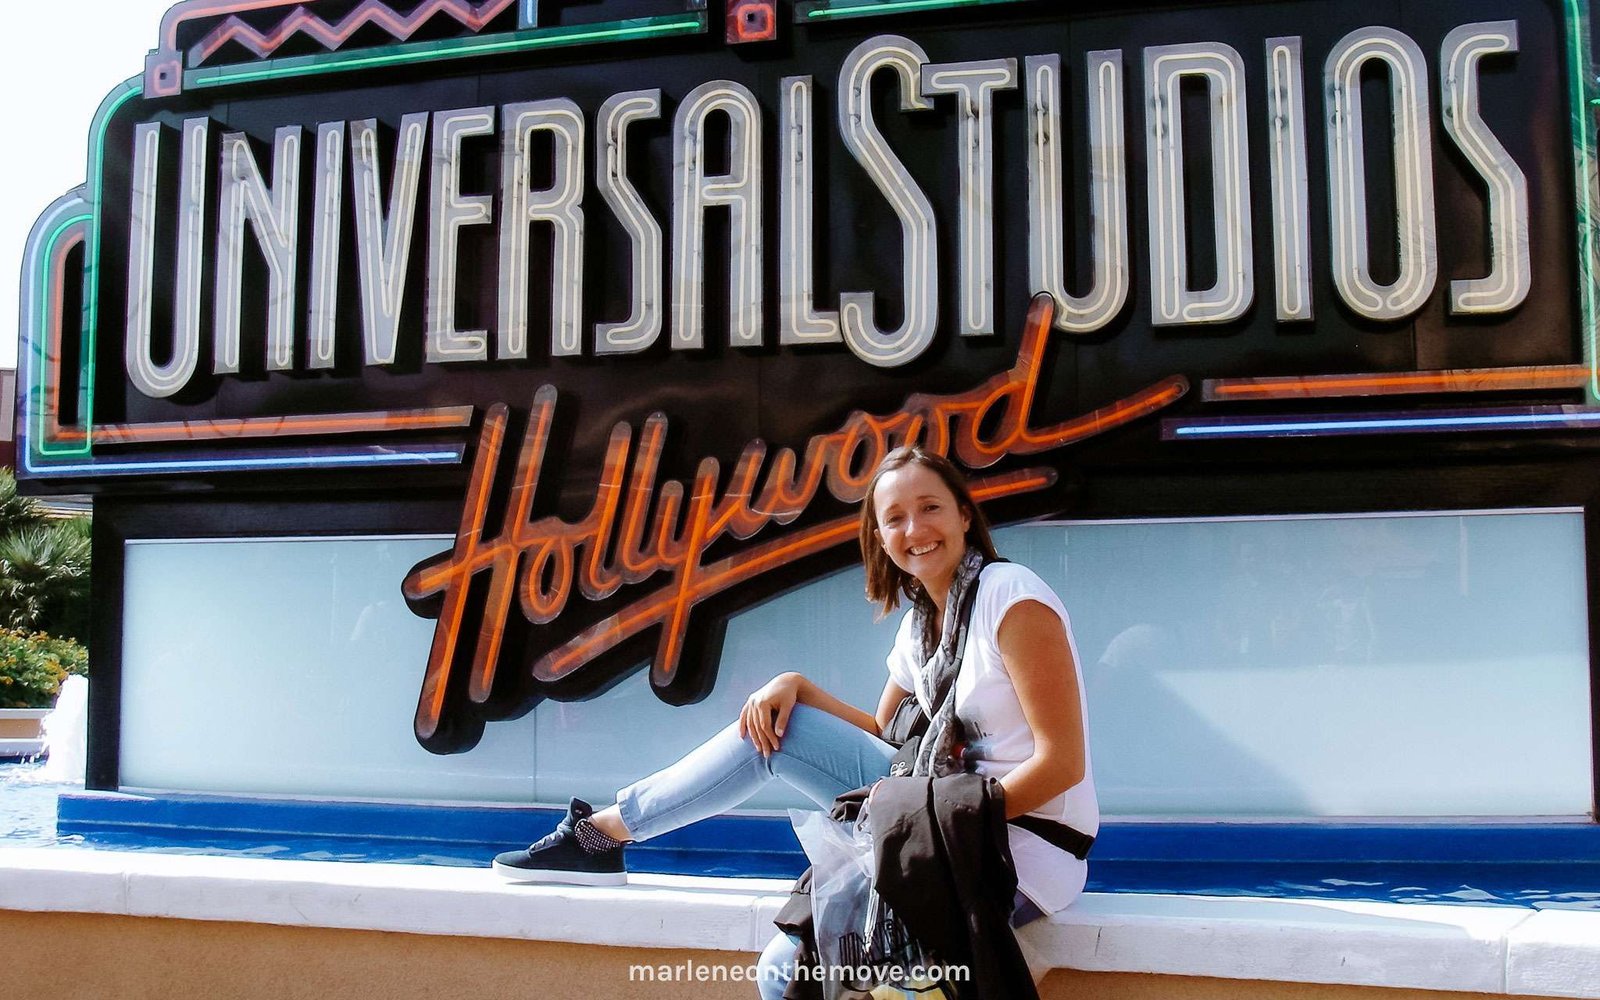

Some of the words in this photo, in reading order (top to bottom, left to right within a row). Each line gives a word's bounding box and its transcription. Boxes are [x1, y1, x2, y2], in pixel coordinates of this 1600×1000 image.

[125, 75, 844, 398] UNIVERSAL
[838, 20, 1531, 367] STUDIOS
[403, 292, 1189, 740] Hollywood
